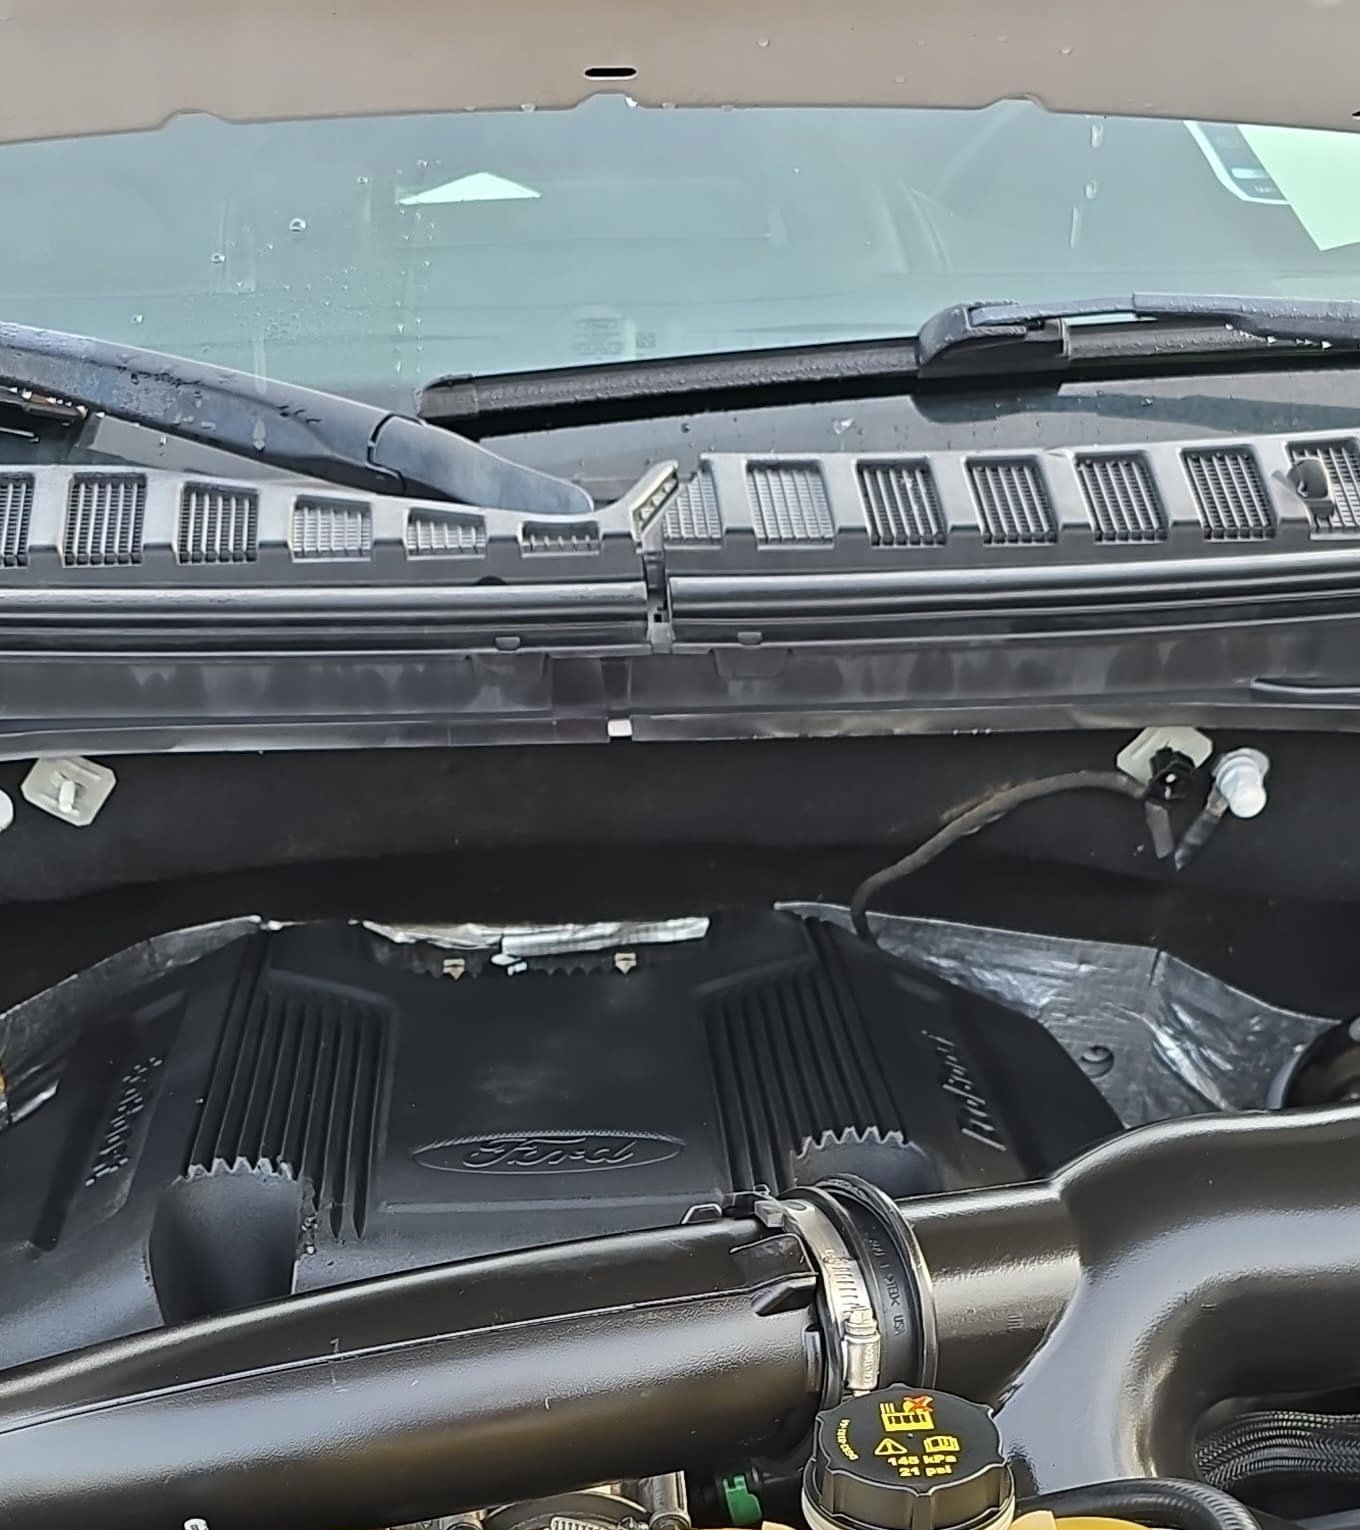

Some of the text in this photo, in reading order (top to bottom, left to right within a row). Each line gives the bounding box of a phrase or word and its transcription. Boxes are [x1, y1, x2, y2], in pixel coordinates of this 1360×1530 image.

[922, 1453, 957, 1465] kPa
[899, 1464, 952, 1477] 21 psi
